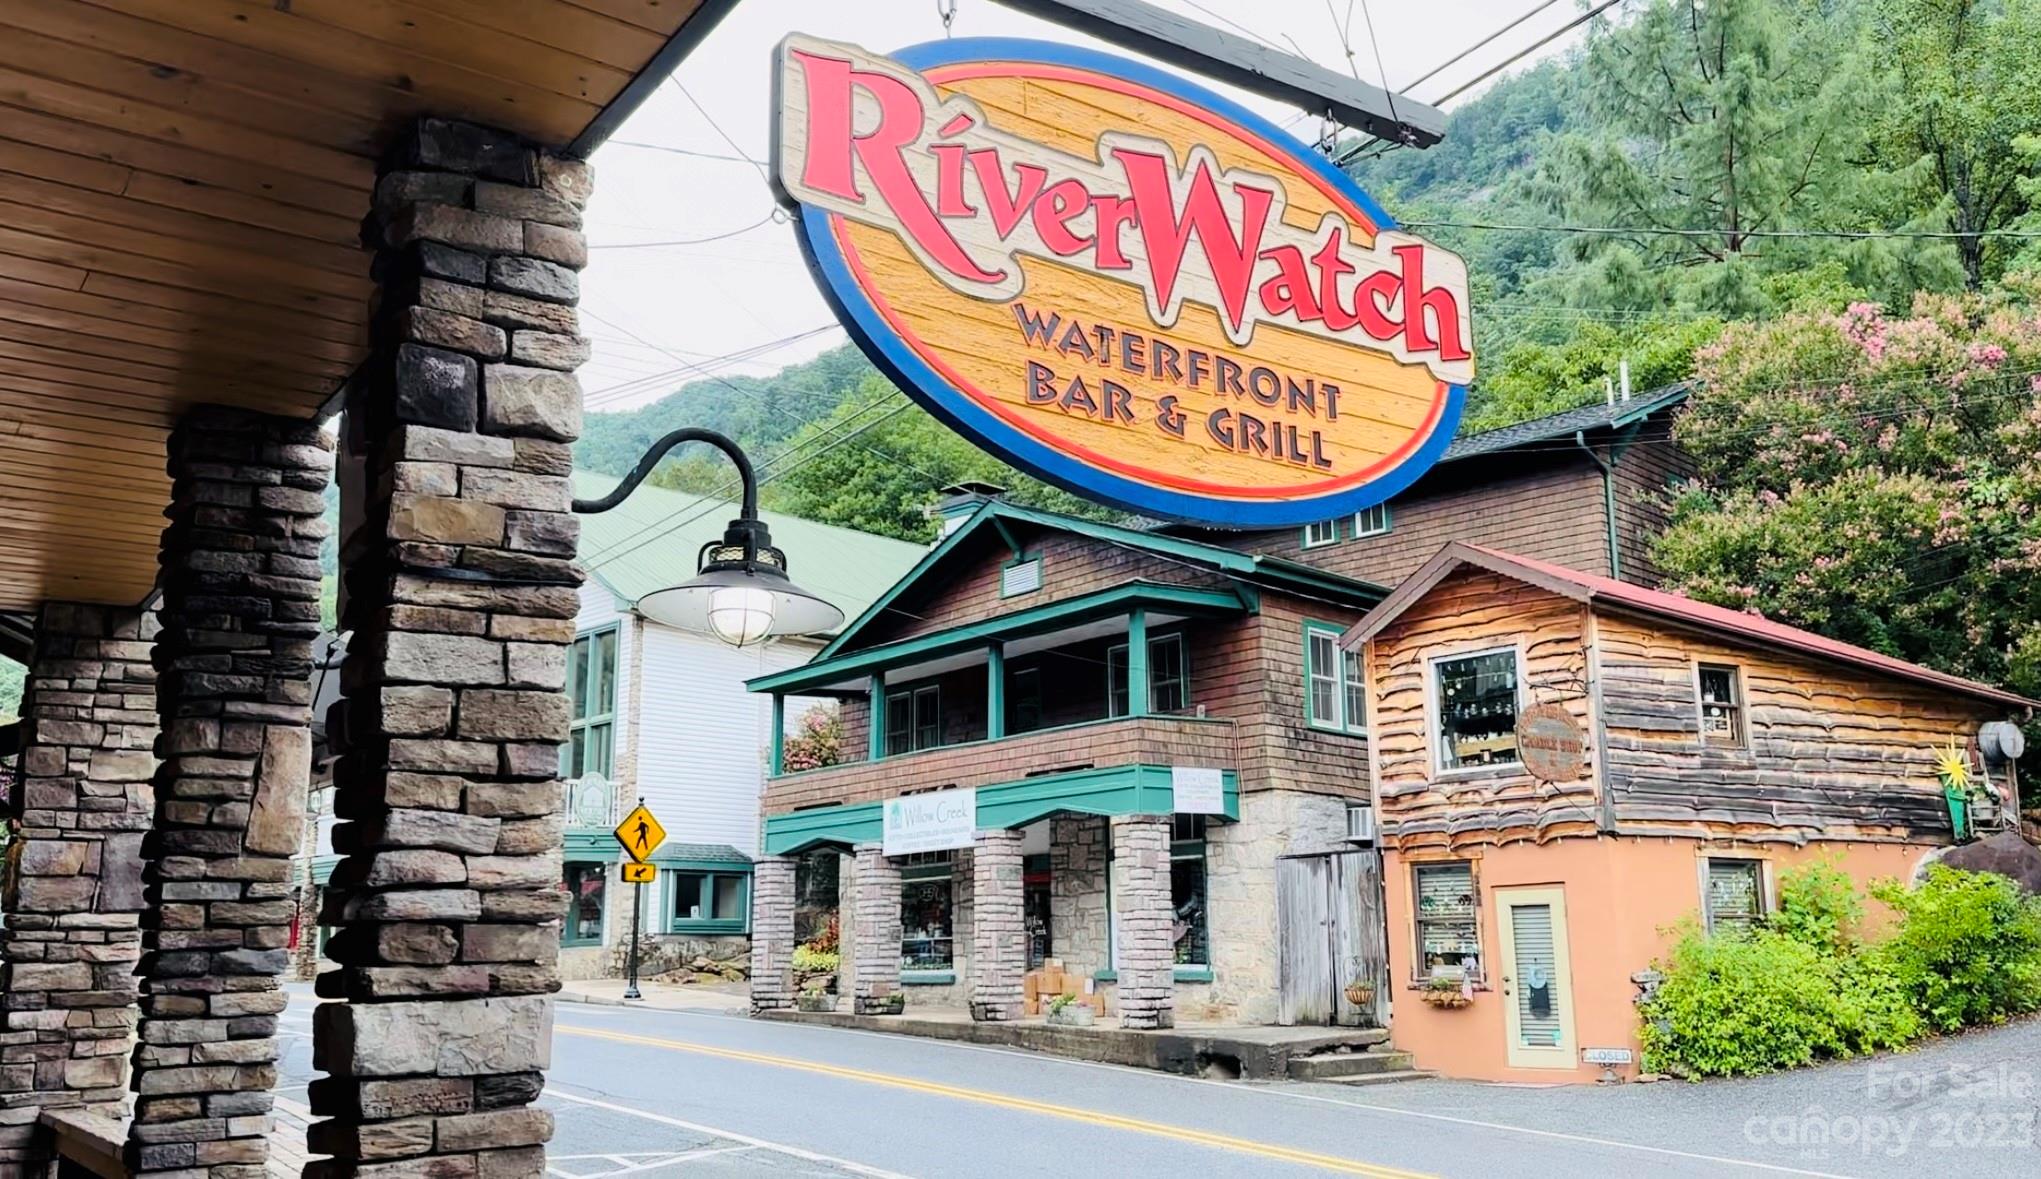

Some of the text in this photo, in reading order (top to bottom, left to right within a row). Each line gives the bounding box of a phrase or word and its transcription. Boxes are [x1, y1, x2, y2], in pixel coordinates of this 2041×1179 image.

[1011, 302, 1341, 422] WATERFRONT
[1026, 360, 1333, 469] BAR & GRILL
[904, 800, 968, 828] Willow Creek
